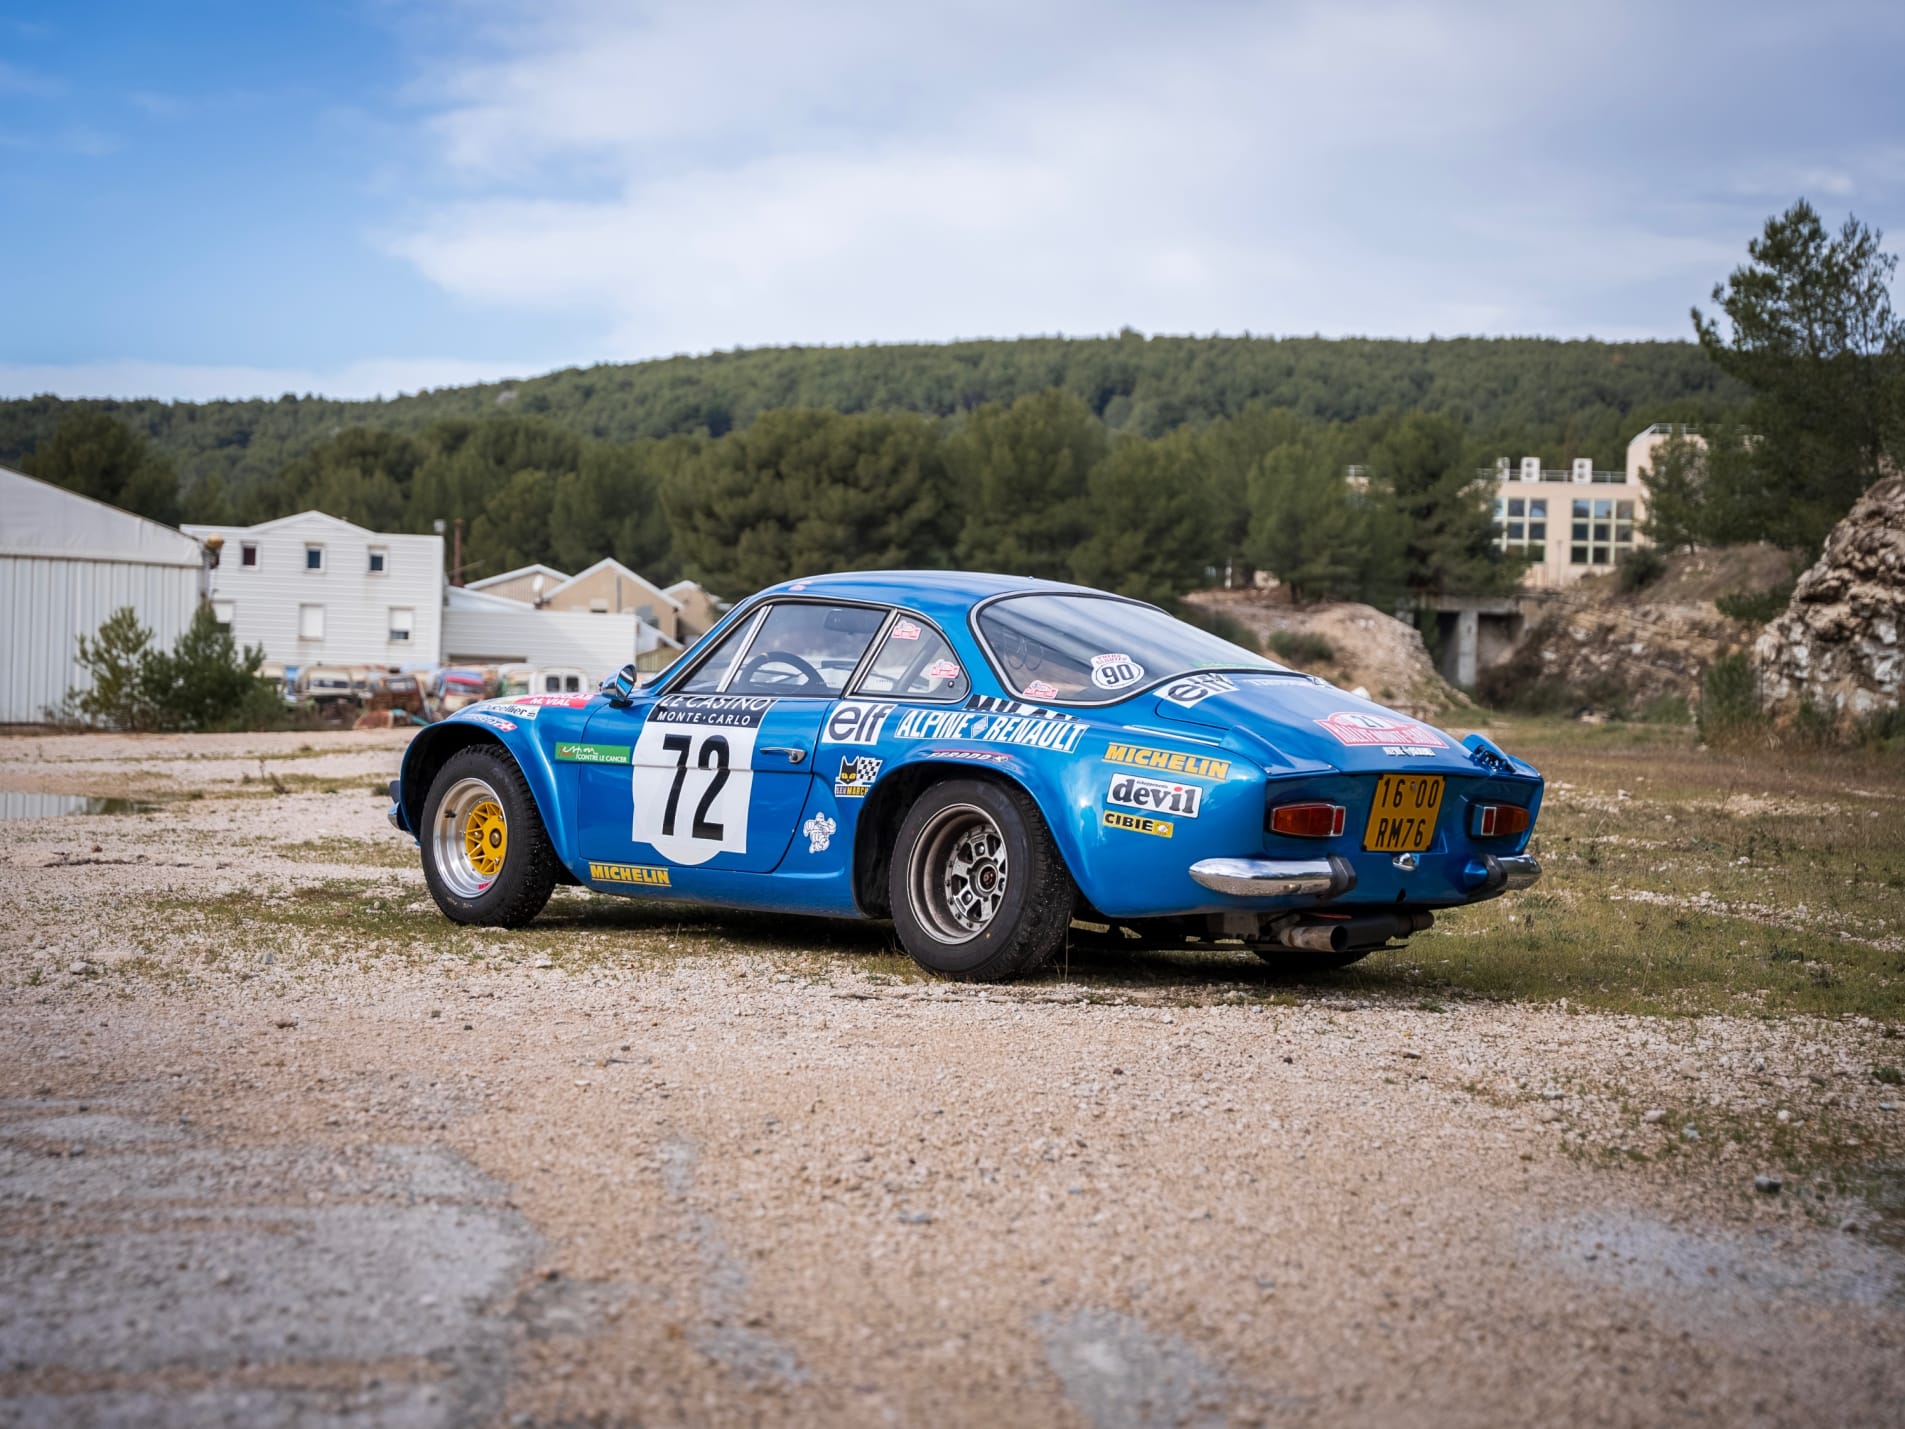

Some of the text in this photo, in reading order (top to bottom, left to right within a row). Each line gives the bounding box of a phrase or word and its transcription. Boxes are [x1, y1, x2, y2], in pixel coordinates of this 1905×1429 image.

[1101, 663, 1135, 685] 90
[660, 695, 771, 711] LE CASINO
[828, 703, 889, 742] elf
[897, 710, 1089, 752] ALPINE RENAULT
[1104, 743, 1230, 779] MICHELIN
[662, 733, 731, 841] 72
[1112, 778, 1196, 814] devil
[1104, 813, 1154, 832] CIBIE
[590, 864, 670, 884] MICHELIN
